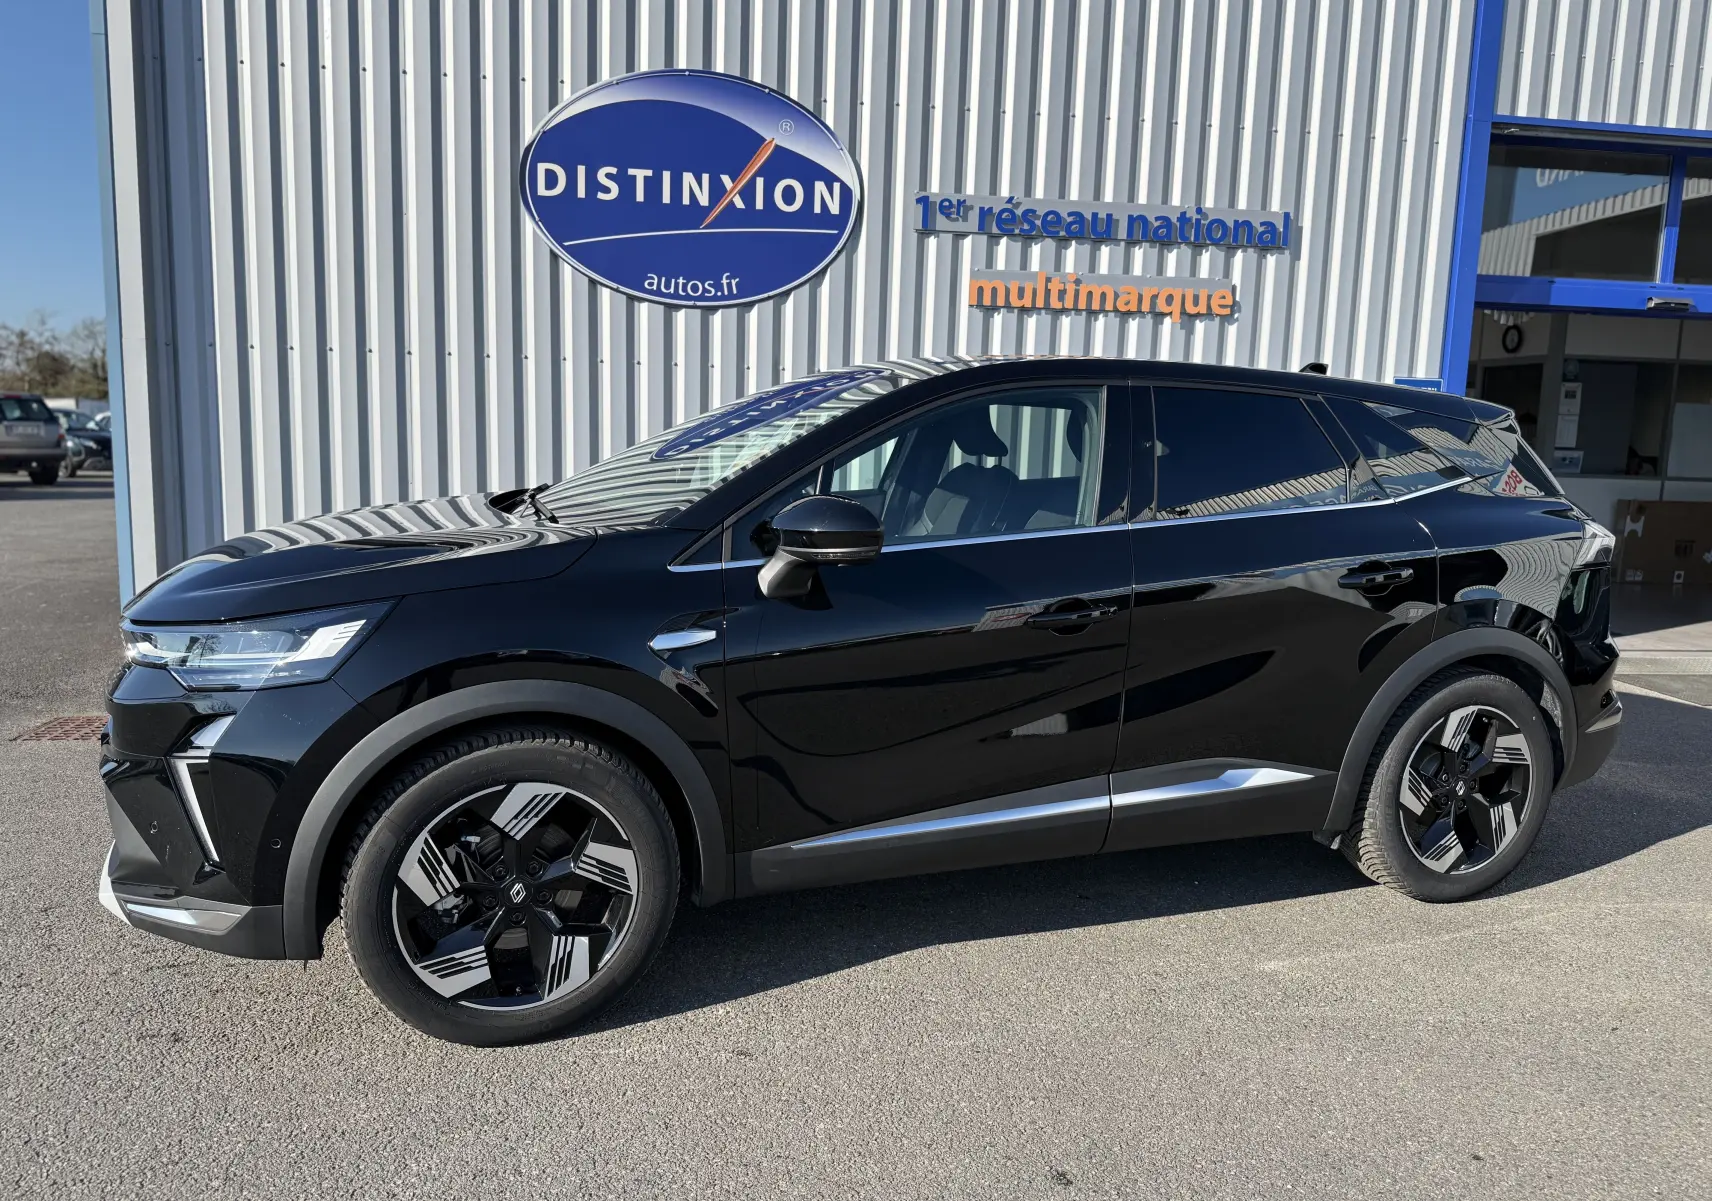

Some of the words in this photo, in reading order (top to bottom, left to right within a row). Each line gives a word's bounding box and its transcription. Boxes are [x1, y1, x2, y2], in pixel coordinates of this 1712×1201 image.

[537, 138, 841, 228] DISTINXION
[915, 195, 966, 229] 1er
[978, 196, 1113, 239] réseau
[1126, 207, 1291, 247] national
[644, 273, 740, 297] autos.fr
[969, 271, 1234, 322] multimarque
